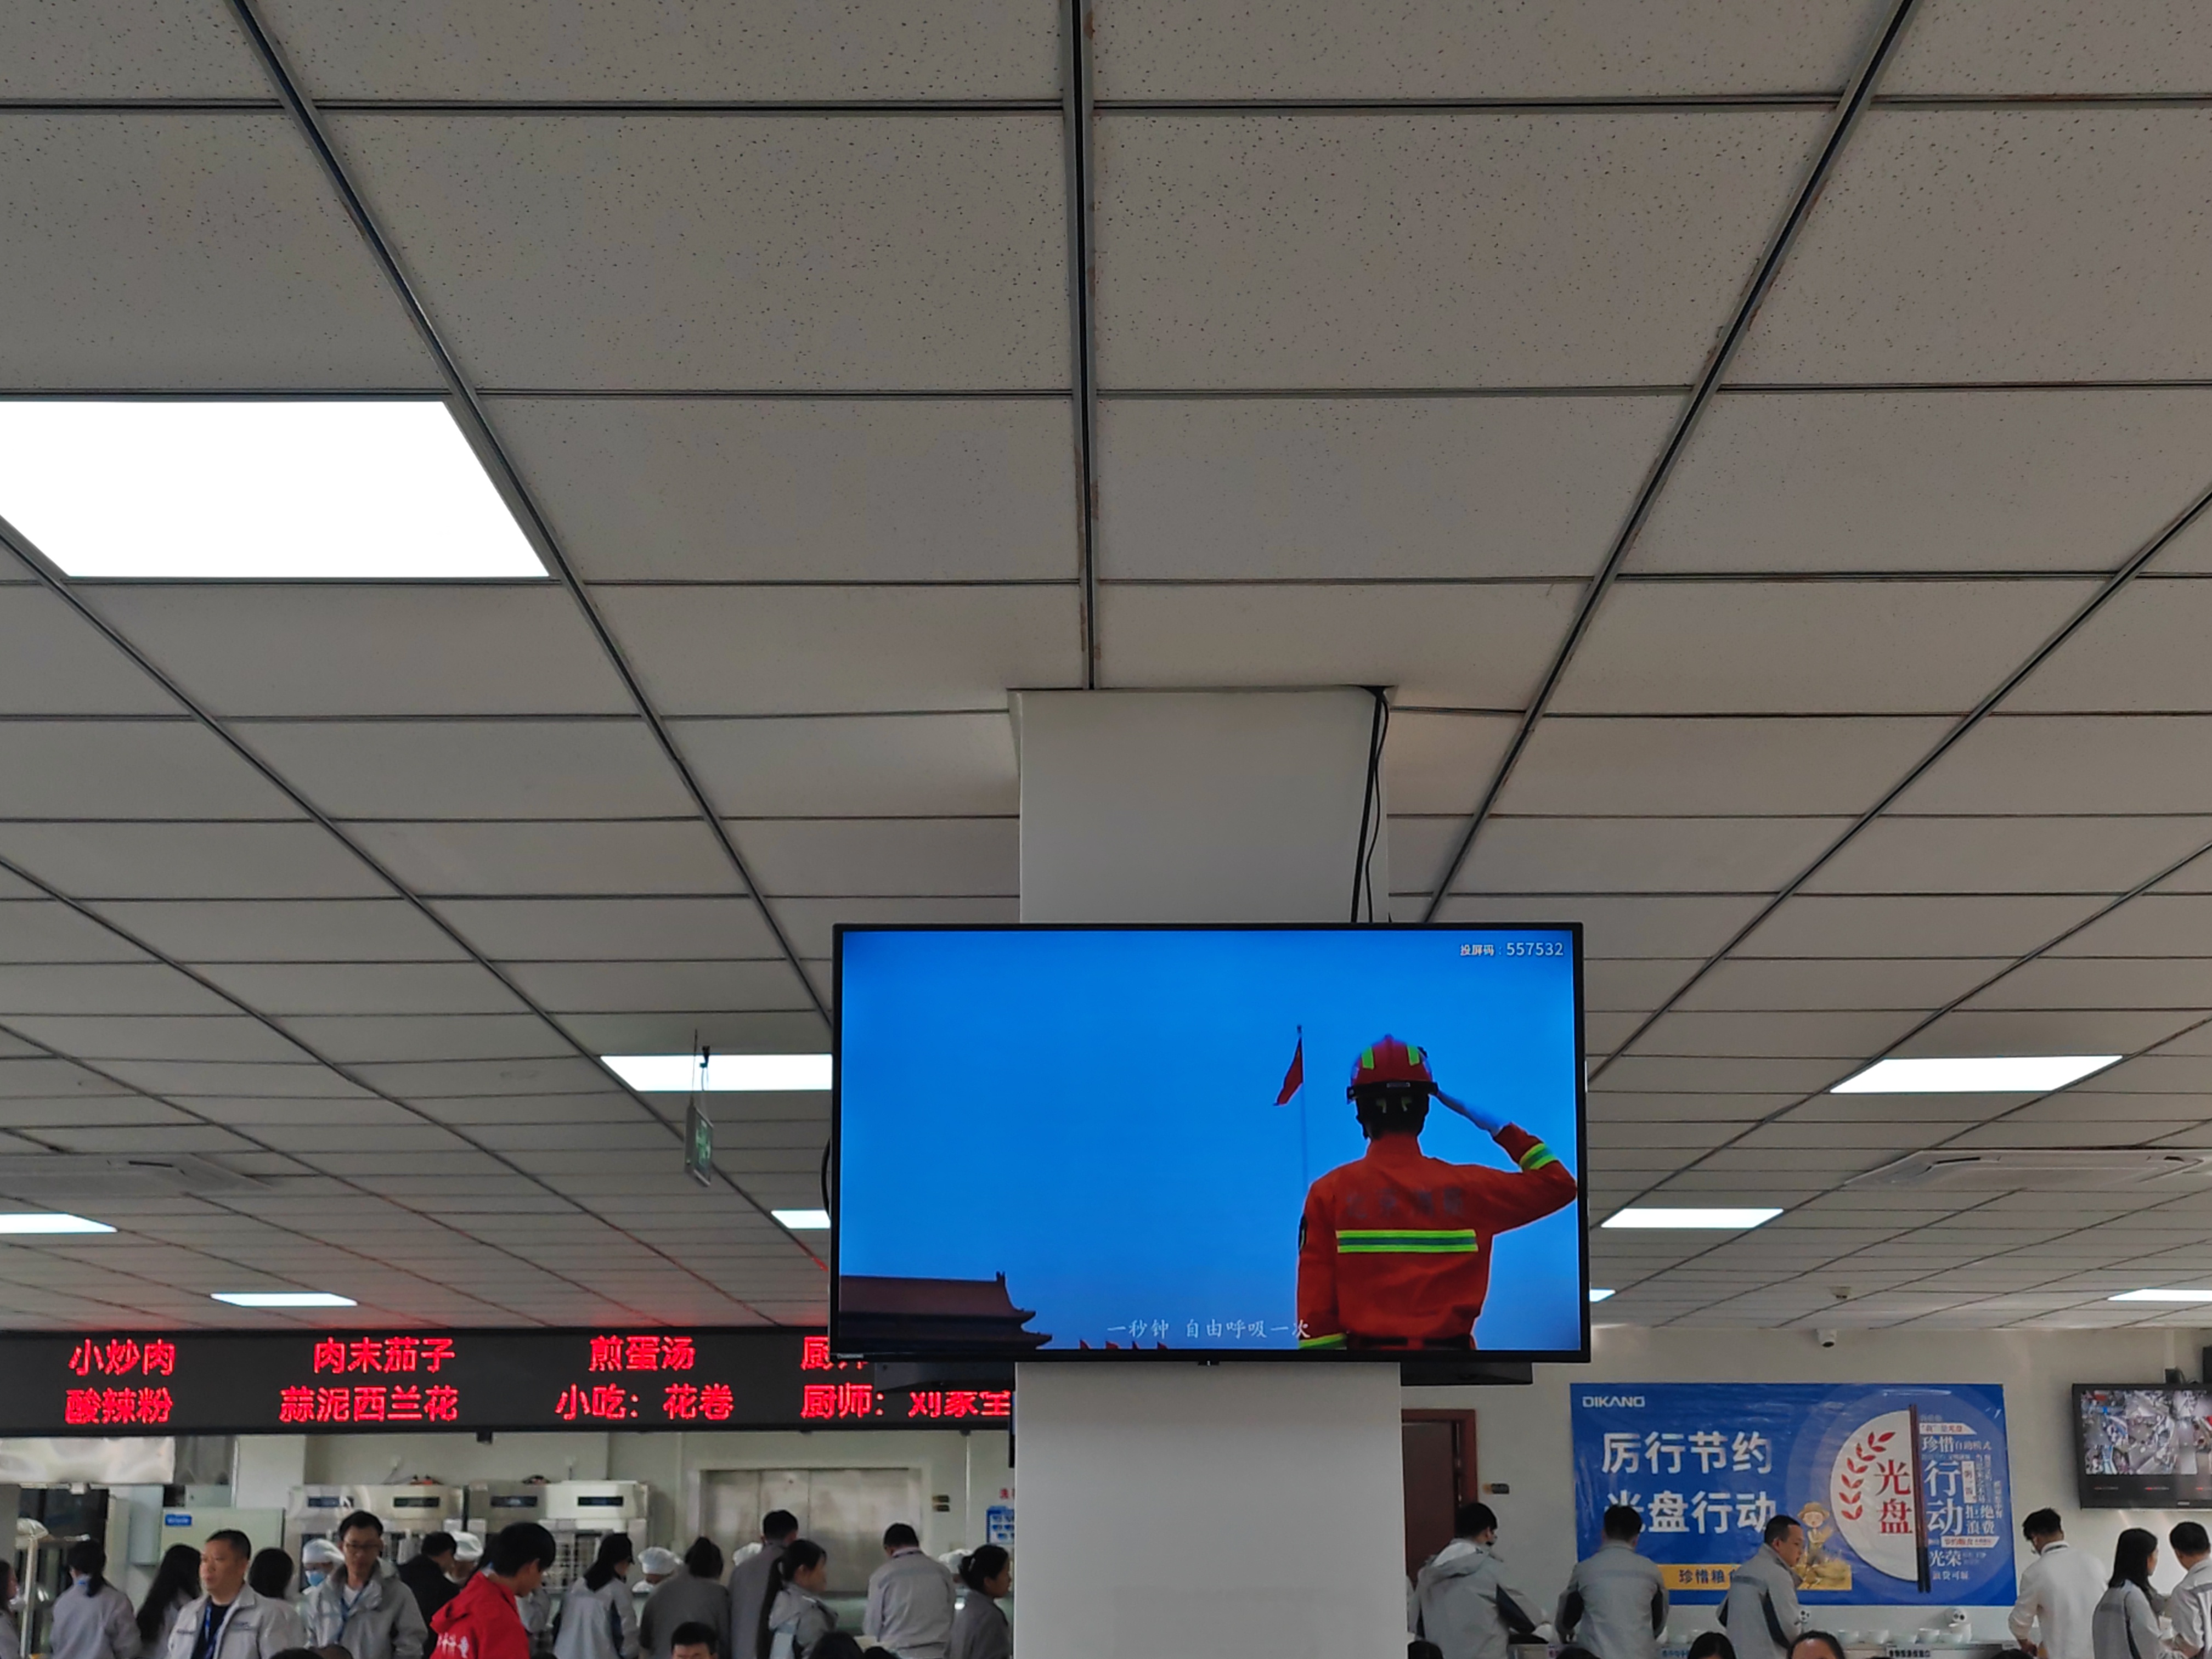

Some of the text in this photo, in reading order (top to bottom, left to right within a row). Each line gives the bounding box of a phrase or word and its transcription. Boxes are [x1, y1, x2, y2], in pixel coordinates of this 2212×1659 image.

[1107, 1318, 1311, 1339] 一秒钟 自由呼吸一次
[69, 1338, 176, 1376] 小炒肉
[314, 1336, 456, 1374] 肉末茄子
[590, 1335, 696, 1372] 煎蛋汤
[800, 1335, 868, 1370] 厨
[65, 1387, 174, 1424] 酸辣粉
[279, 1385, 459, 1423] 蒜泥西兰花
[1602, 1431, 1773, 1474] 厉行节约
[1874, 1459, 1912, 1534] 光盘
[1924, 1459, 1963, 1536] 行动
